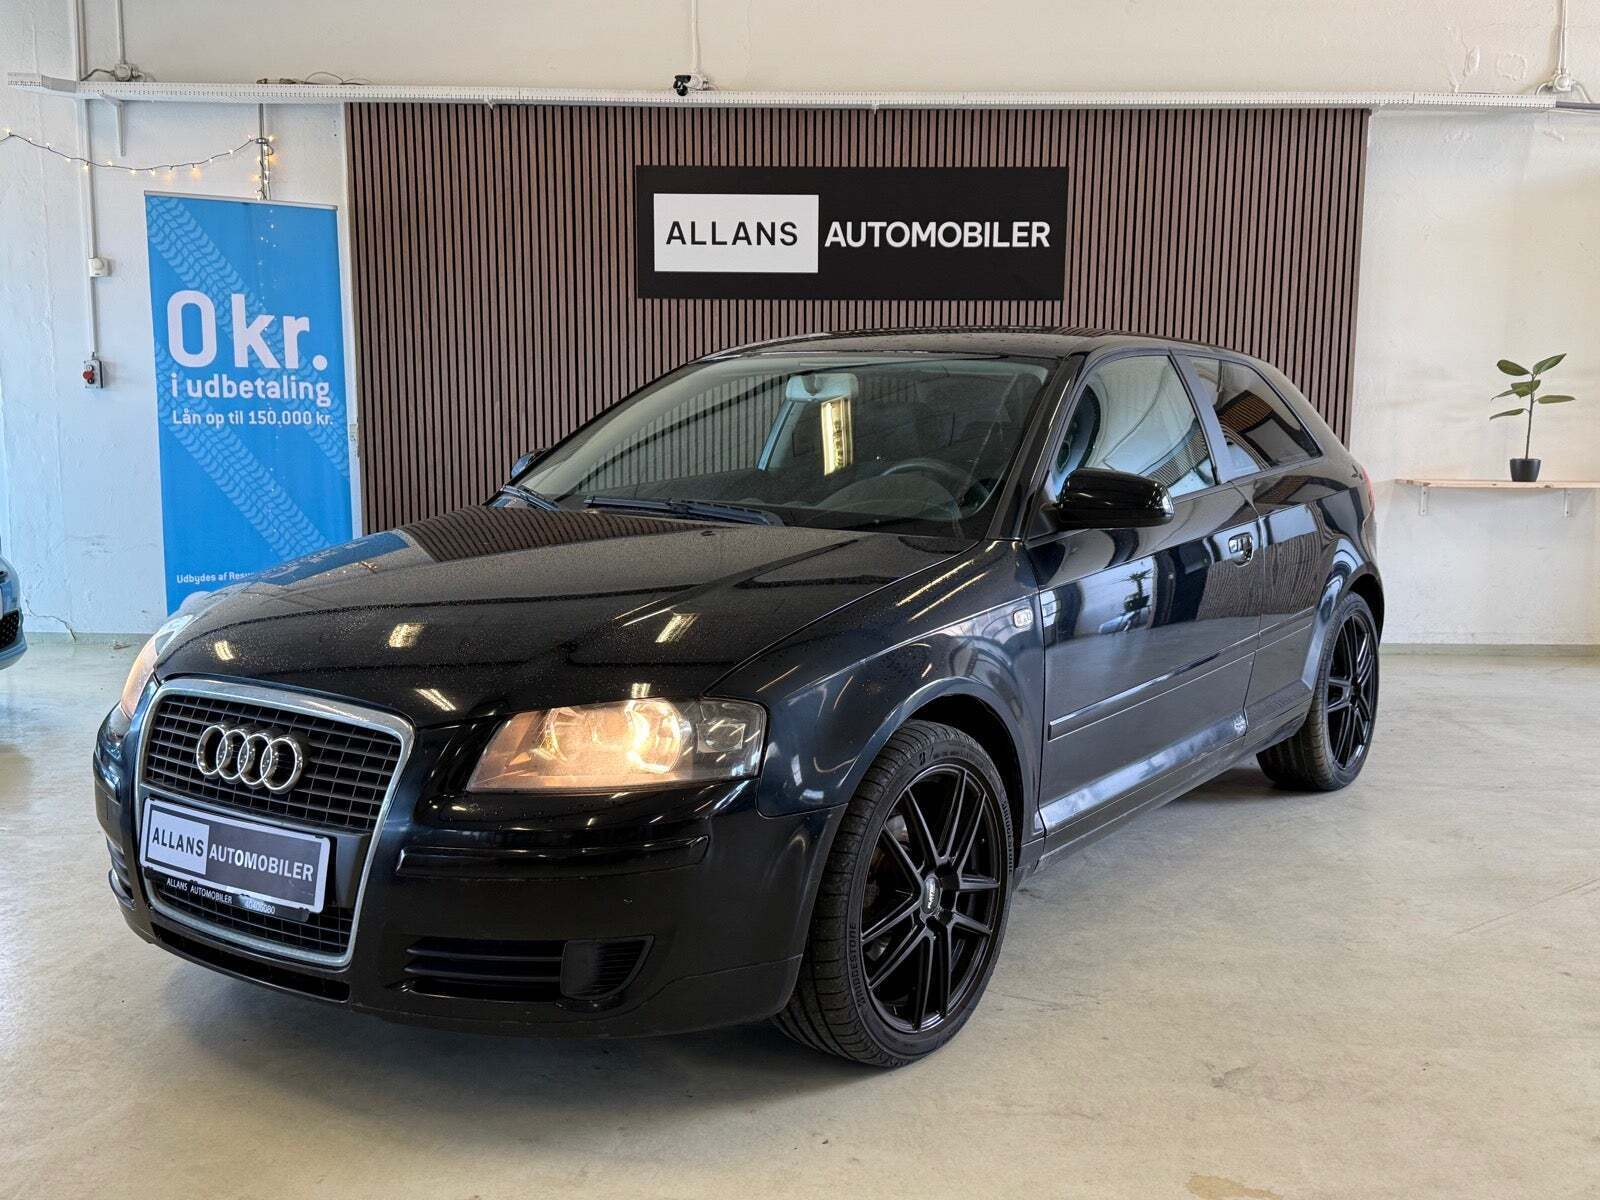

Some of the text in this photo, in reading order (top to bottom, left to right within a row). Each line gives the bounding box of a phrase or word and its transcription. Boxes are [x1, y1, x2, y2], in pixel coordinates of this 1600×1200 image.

[666, 220, 1051, 249] ALLANS AUTOMOBILER
[166, 289, 328, 371] 0 kr.
[170, 373, 332, 408] i udbetaling
[172, 408, 334, 428] Lån op til 150.000 kr.
[176, 573, 217, 585] Udbydes
[217, 571, 228, 581] af
[151, 827, 315, 882] ALLANS AUTOMOBILER
[166, 877, 189, 892] ALLANS
[189, 884, 233, 905] AUTOMOBILER
[849, 922, 867, 1008] BRIDGESTONE
